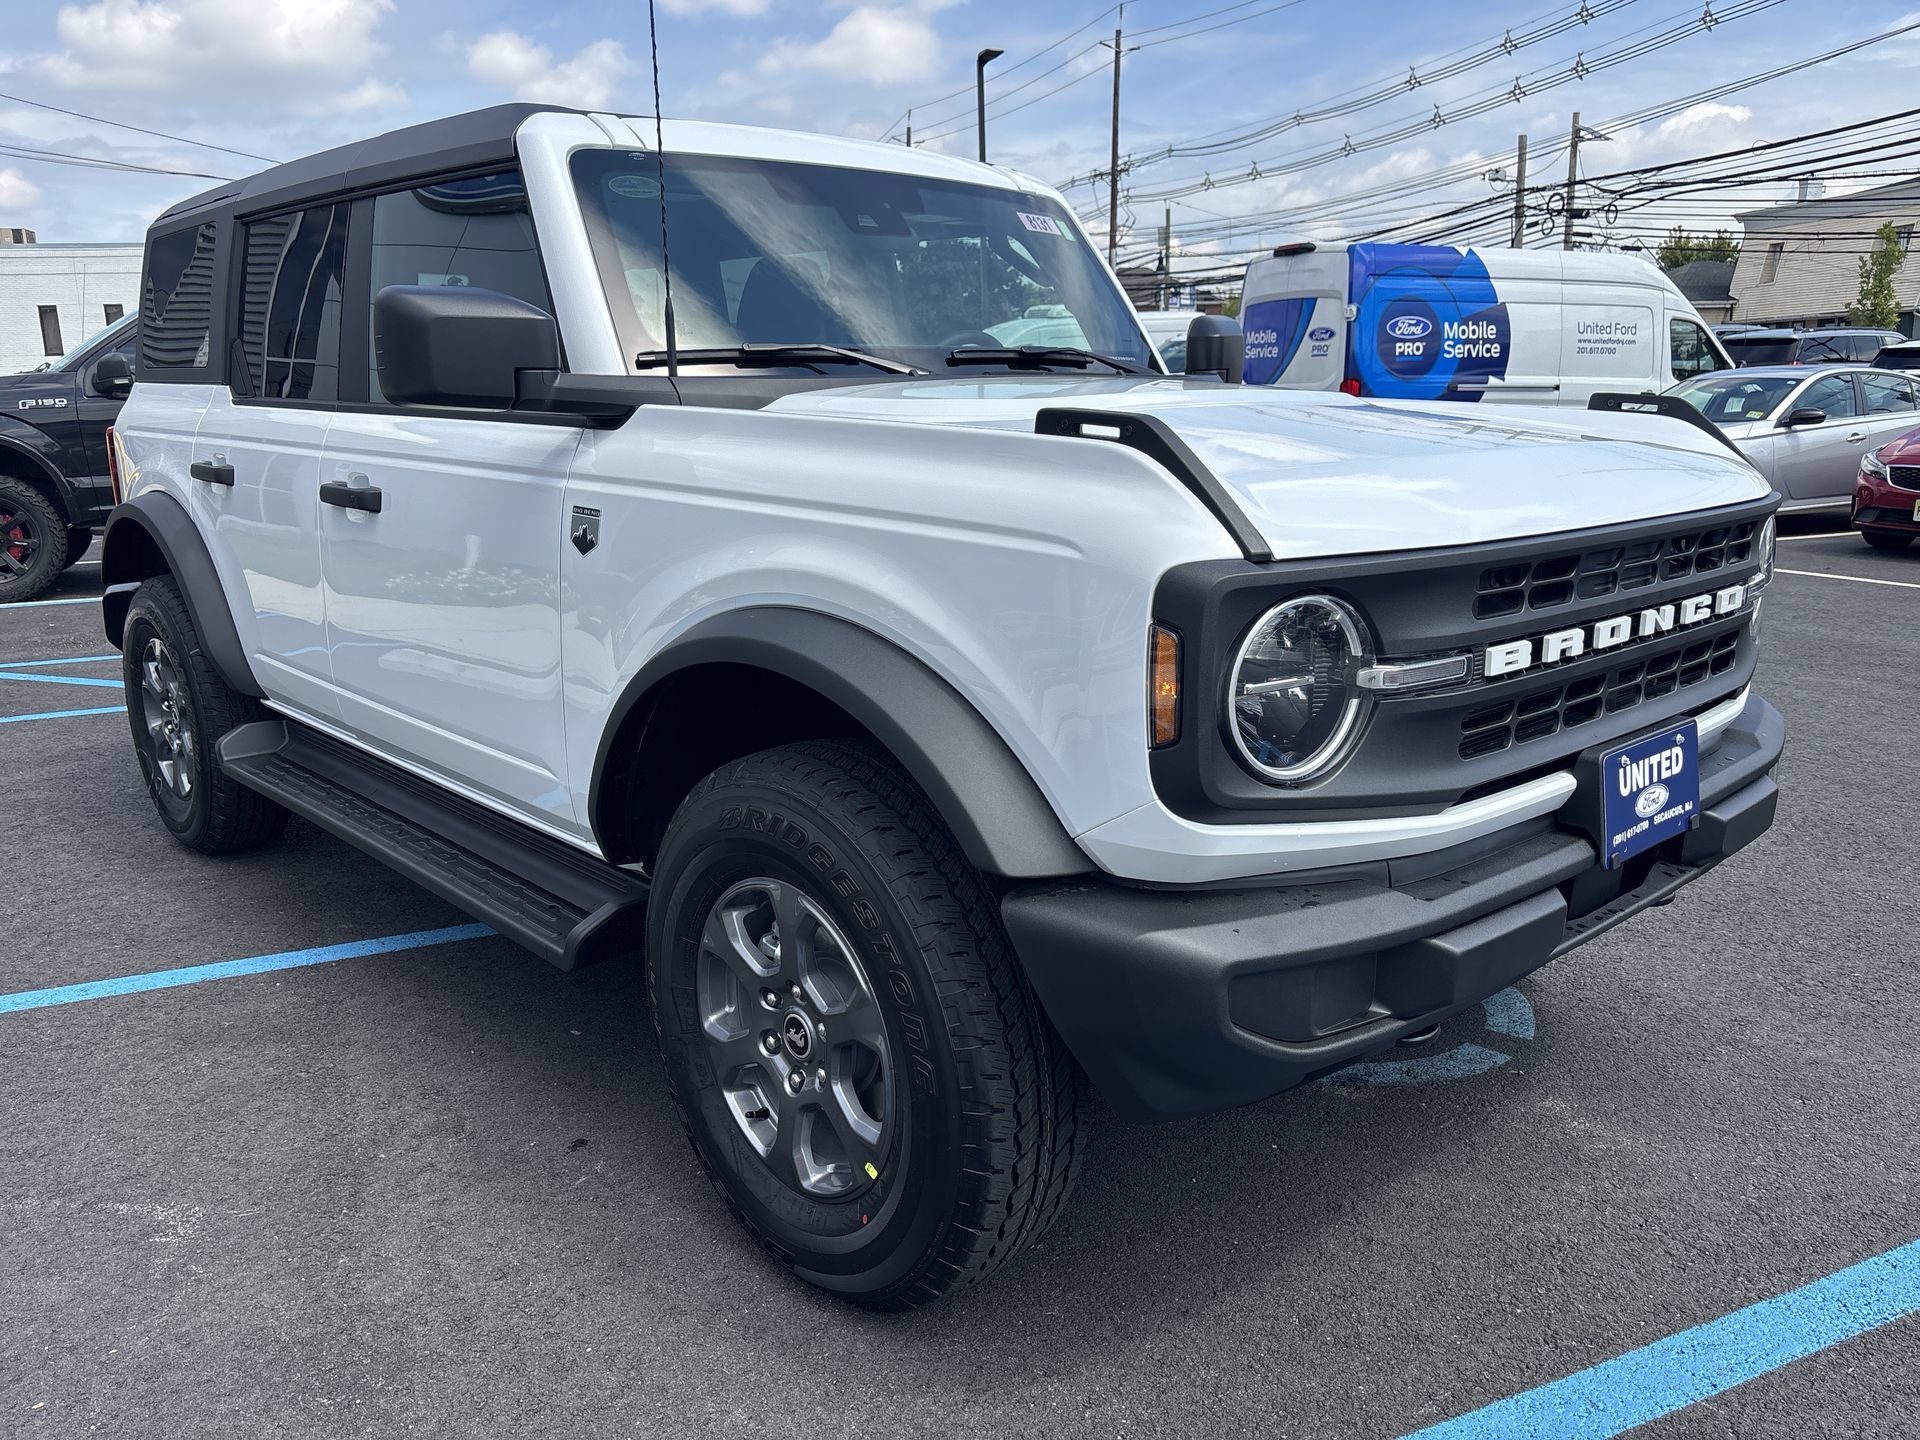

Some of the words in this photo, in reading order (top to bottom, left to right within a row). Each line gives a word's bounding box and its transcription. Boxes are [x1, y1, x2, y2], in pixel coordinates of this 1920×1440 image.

[1394, 319, 1424, 335] Ford
[1443, 321, 1497, 339] Mobile
[1577, 322, 1612, 335] United
[1614, 323, 1637, 336] Ford
[1246, 329, 1277, 344] Mobile
[1245, 345, 1278, 359] Service
[1443, 341, 1501, 358] Service
[1576, 347, 1617, 355] 201.617.0700
[1485, 585, 1745, 677] BRONCO
[1619, 746, 1683, 797] UNITED
[1684, 800, 1693, 812] NJ
[718, 804, 938, 1097] BRIDGESTONE
